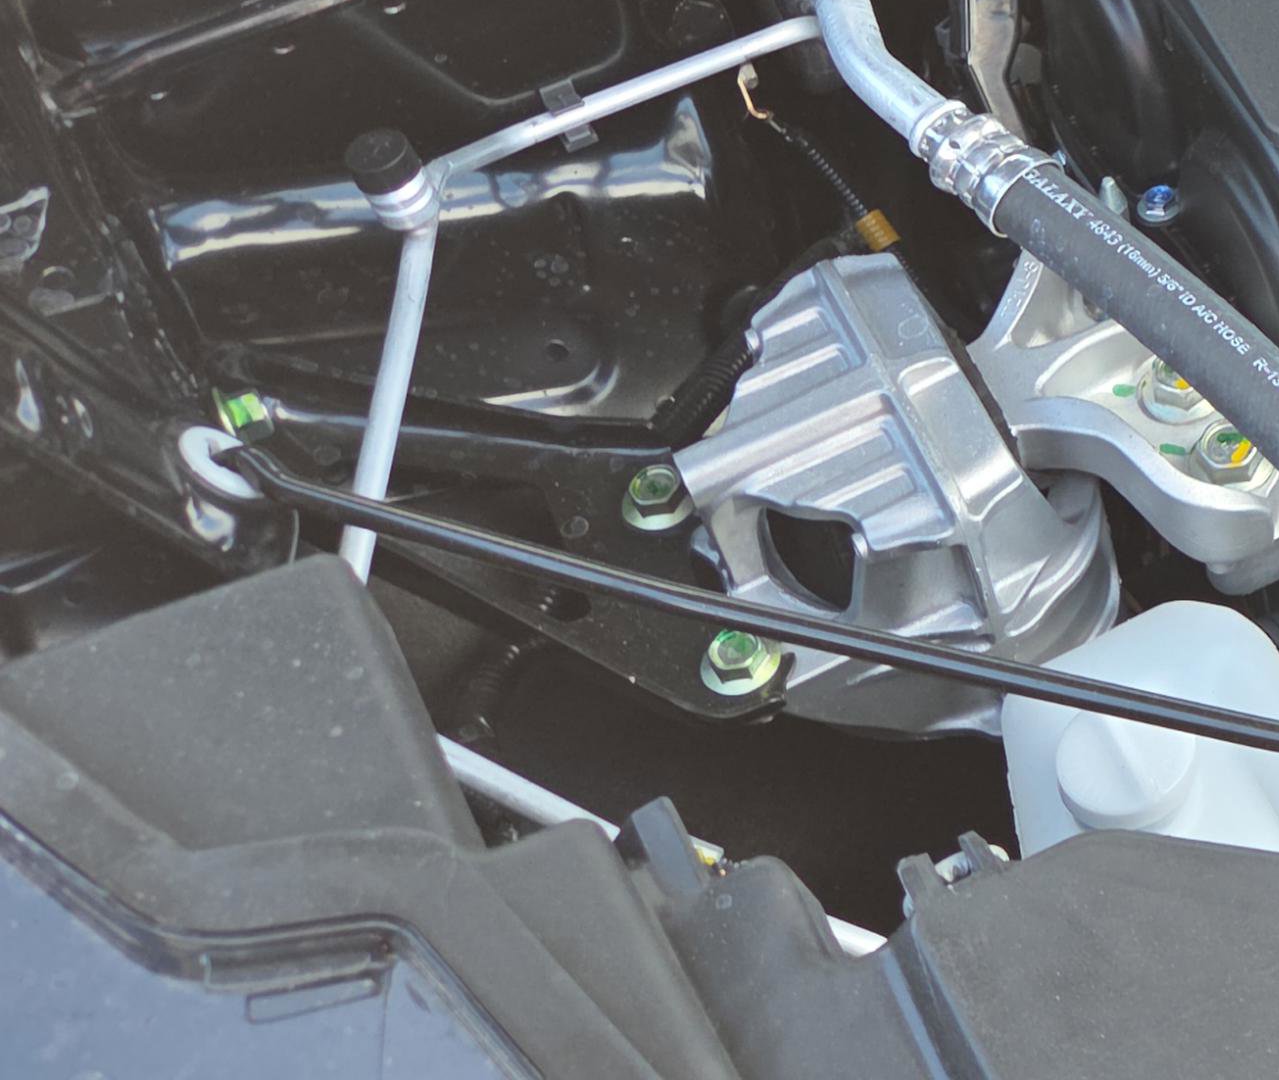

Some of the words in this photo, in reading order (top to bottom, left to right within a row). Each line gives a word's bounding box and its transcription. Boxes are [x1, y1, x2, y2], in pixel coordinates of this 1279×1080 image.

[1177, 289, 1197, 308] ID
[1190, 300, 1218, 327] A/C
[1211, 320, 1250, 356] HOSE
